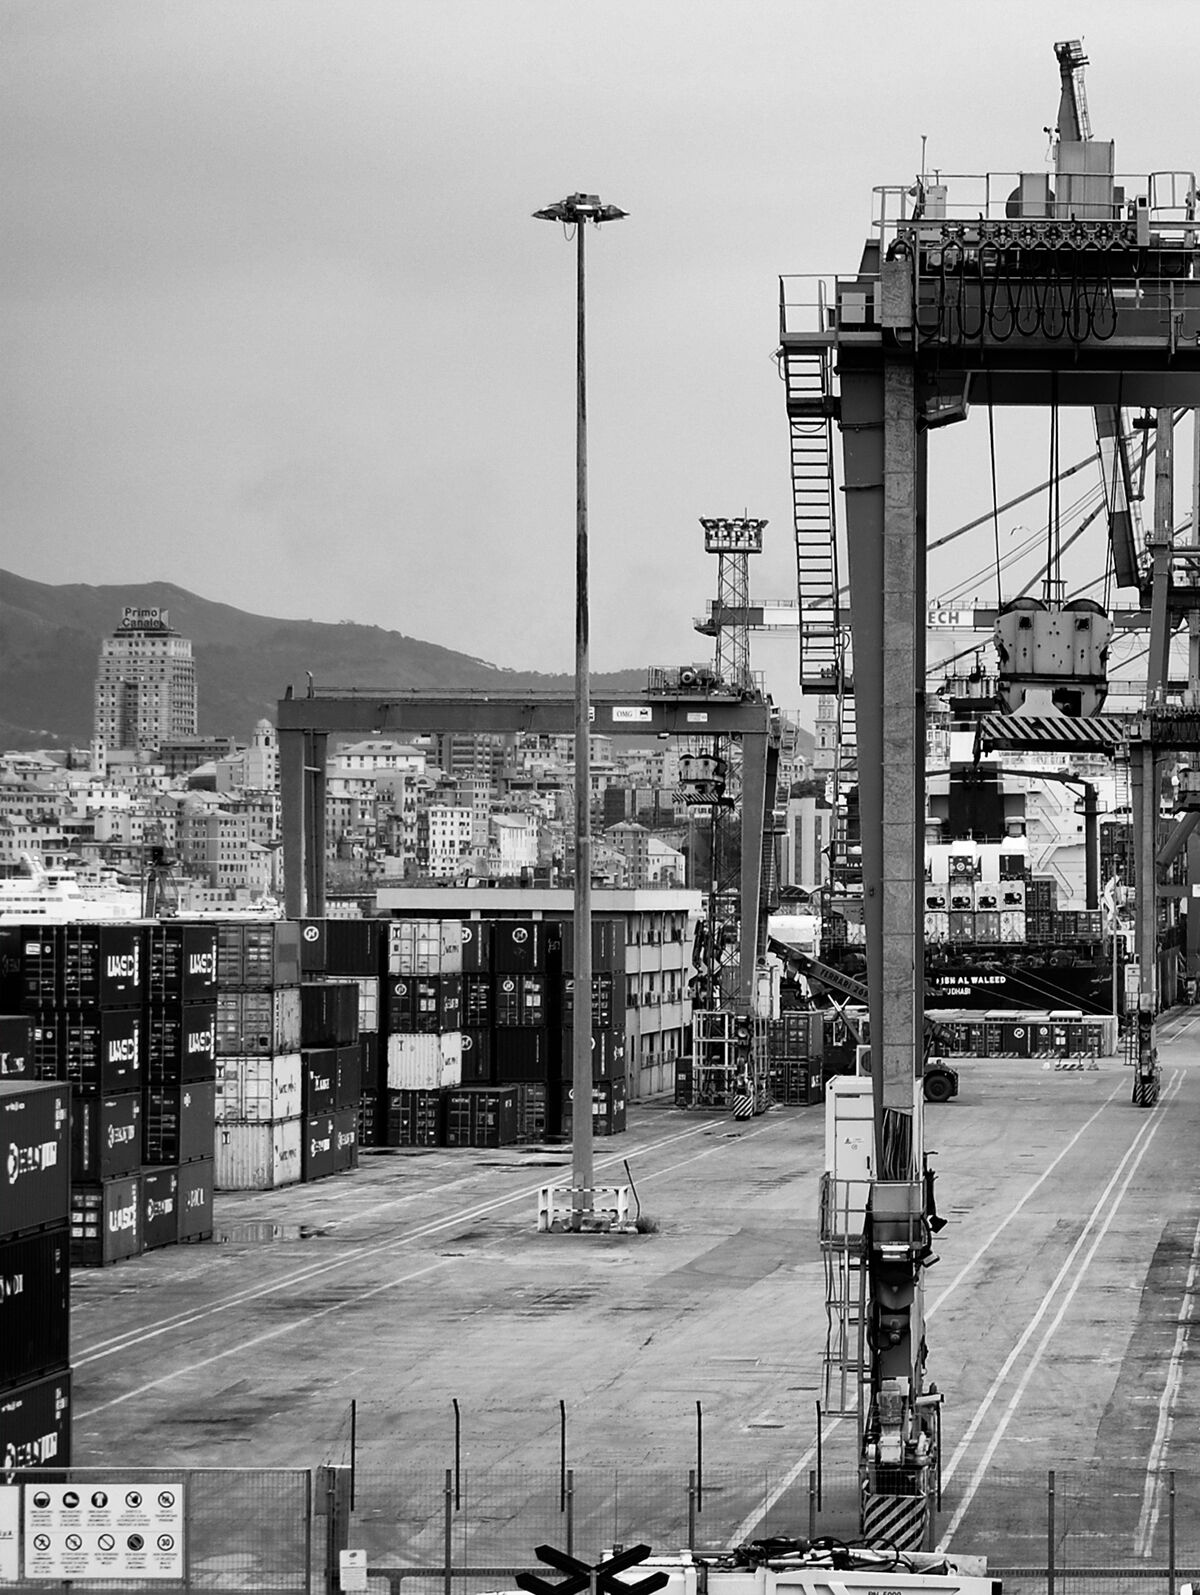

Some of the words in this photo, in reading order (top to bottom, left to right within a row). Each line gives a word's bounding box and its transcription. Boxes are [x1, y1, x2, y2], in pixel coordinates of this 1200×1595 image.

[125, 607, 158, 617] Primo
[122, 617, 160, 628] Canale
[928, 611, 960, 624] ECH
[957, 976, 970, 985] AL
[971, 976, 1006, 985] WALEED
